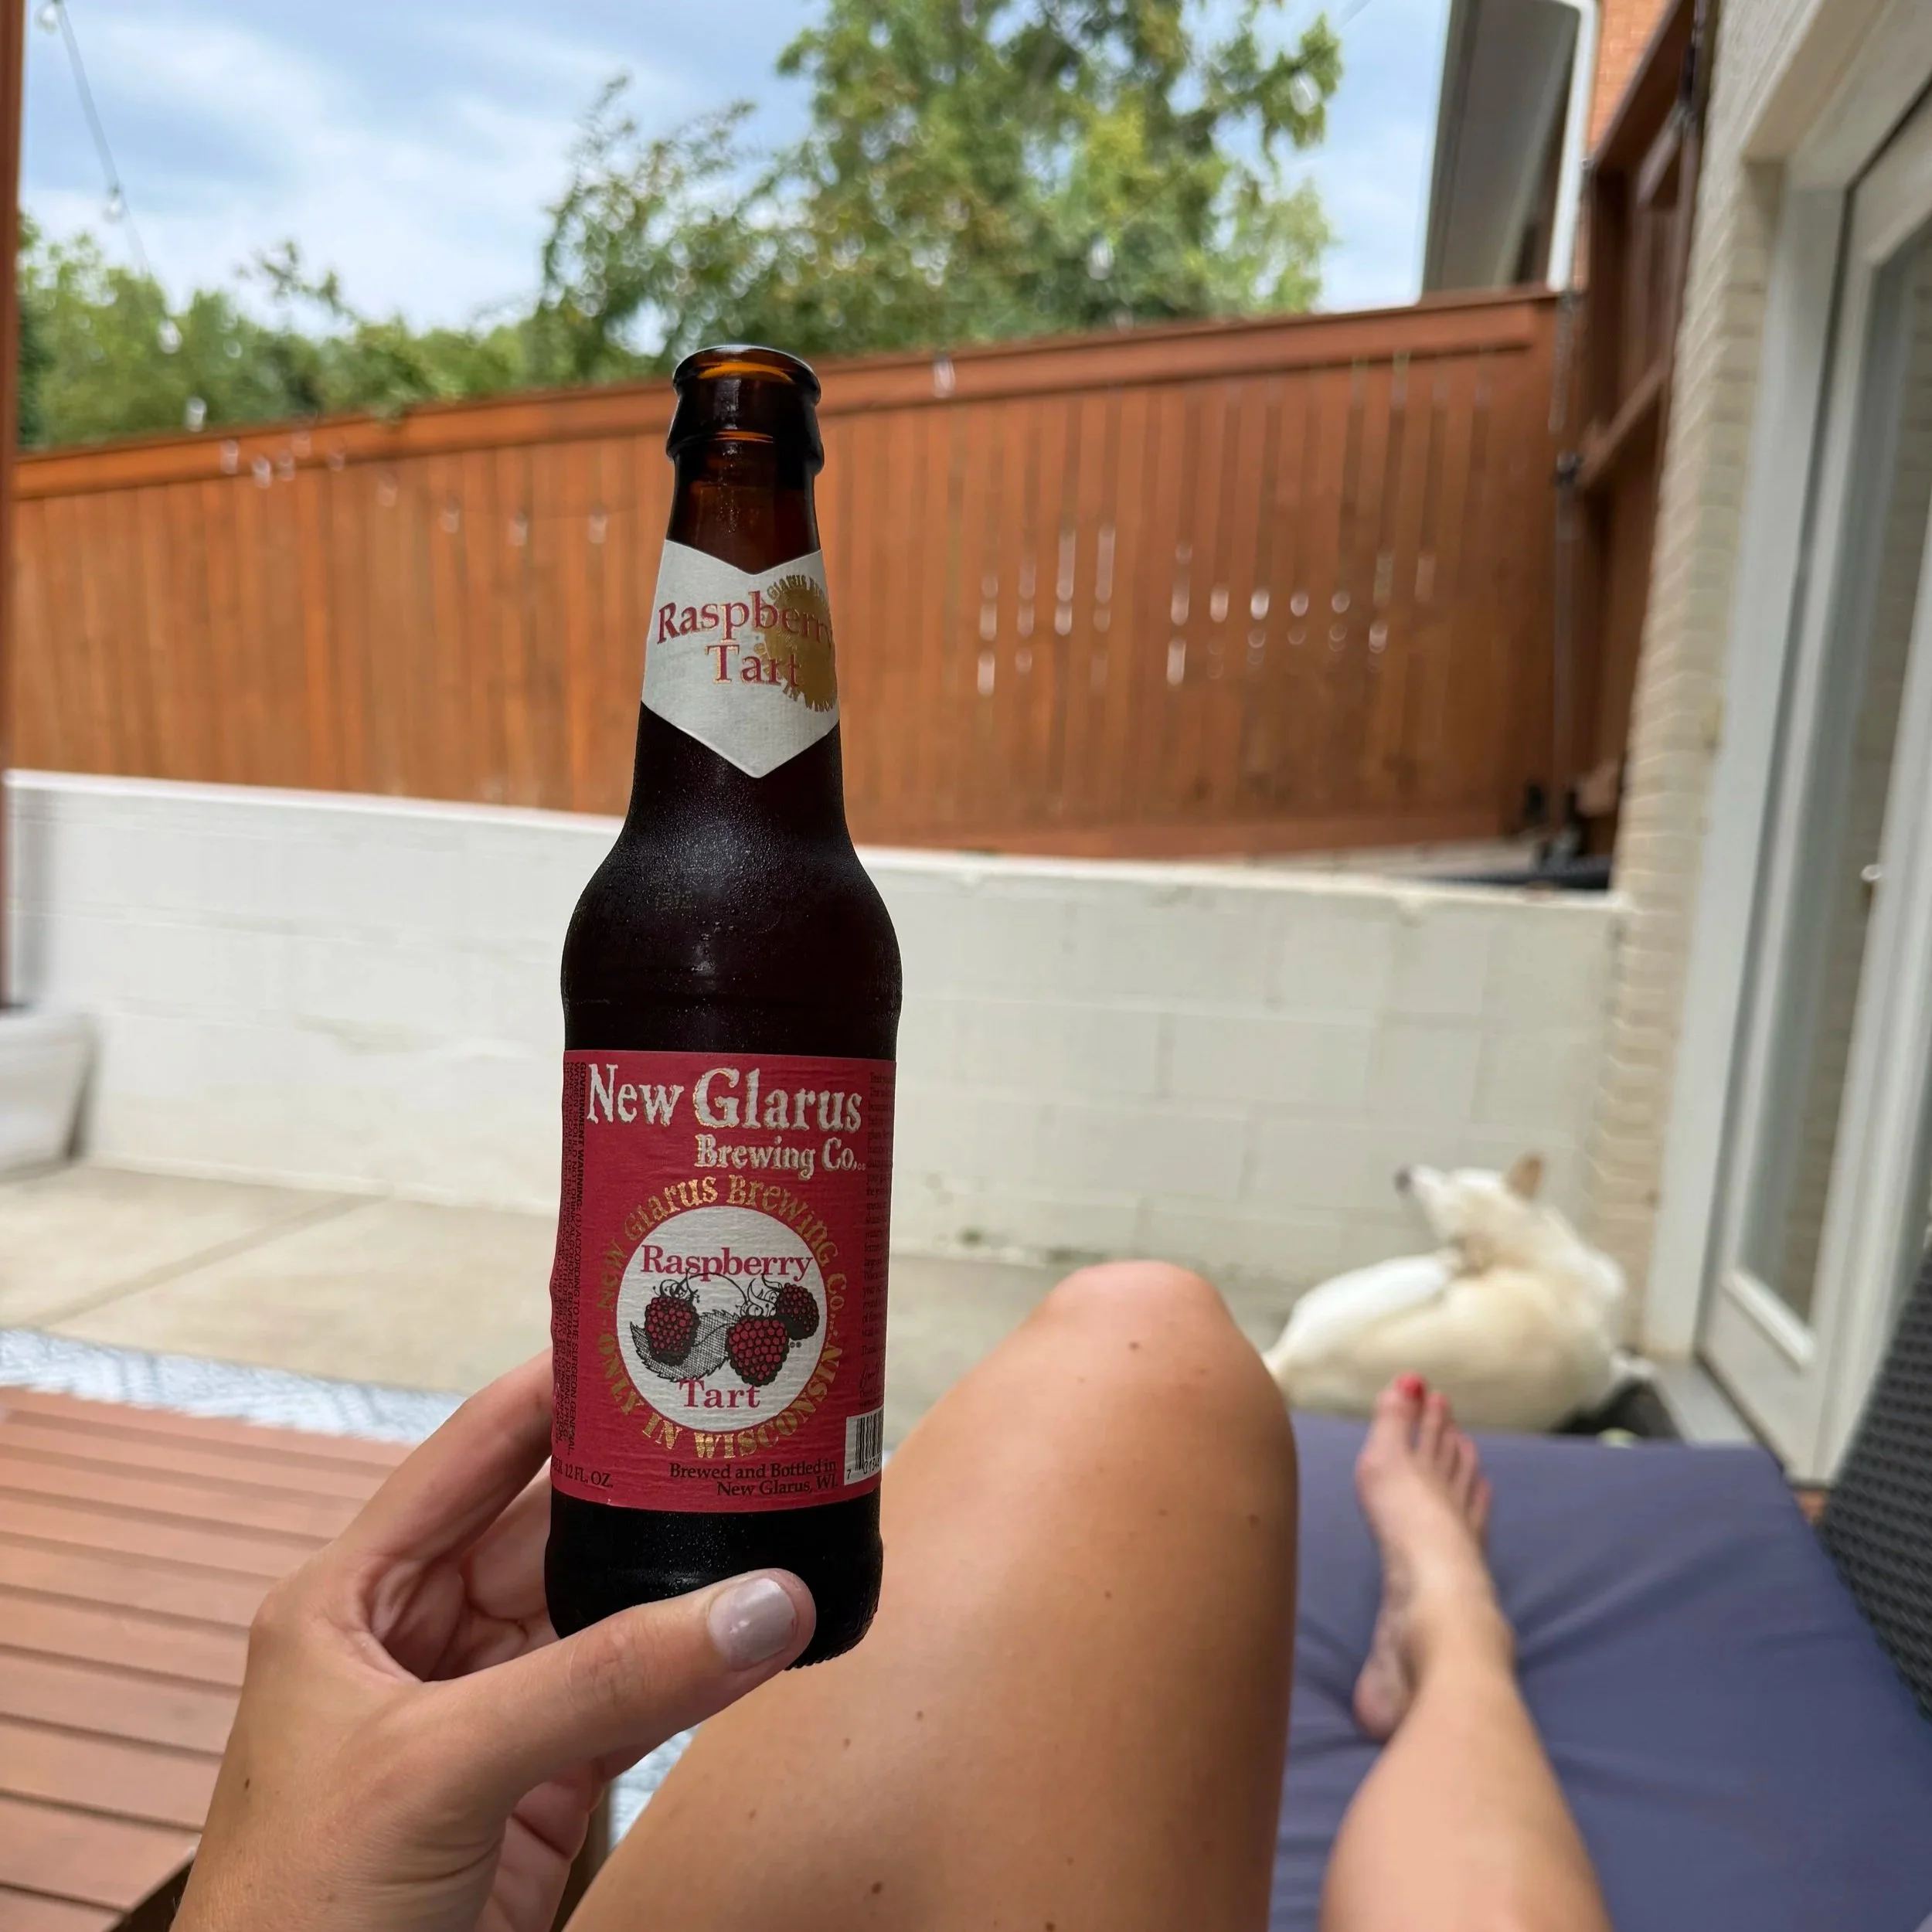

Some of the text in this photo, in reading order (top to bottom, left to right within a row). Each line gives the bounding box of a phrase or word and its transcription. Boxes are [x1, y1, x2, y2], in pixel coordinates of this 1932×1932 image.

[705, 643, 801, 687] Tart
[578, 1062, 587, 1147] GOVERNMENT
[587, 1063, 862, 1134] New Glarus
[576, 1148, 584, 1211] WARNING:
[694, 1134, 857, 1180] Brewing Co.
[573, 1229, 582, 1296] ACCORDING
[640, 1244, 814, 1282] Raspberry
[572, 1300, 580, 1315] TO
[570, 1343, 579, 1398] SURGEON
[679, 1377, 761, 1409] Tart
[642, 1412, 683, 1450] IN
[694, 1342, 843, 1459] WISCONSIN
[564, 1464, 573, 1479] 12
[590, 1471, 614, 1488] OZ.
[669, 1458, 837, 1479] Brewed and Bottled in
[716, 1481, 756, 1497] New
[759, 1479, 811, 1495] Glarus,
